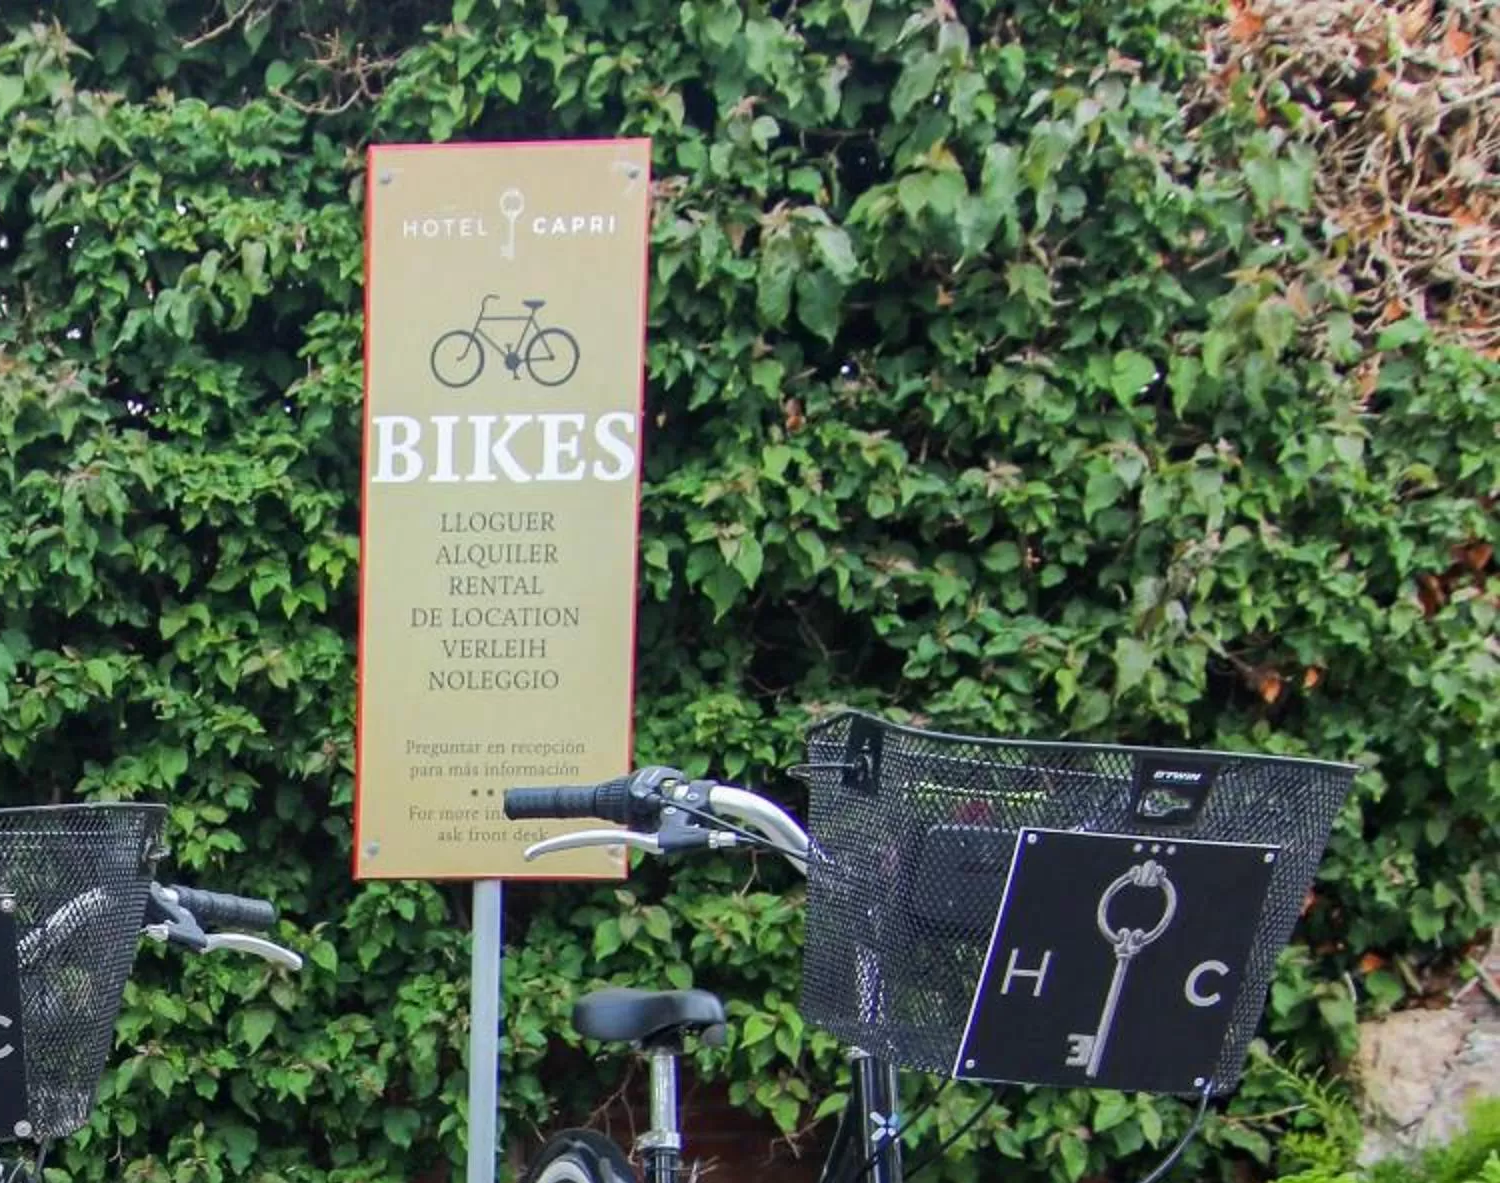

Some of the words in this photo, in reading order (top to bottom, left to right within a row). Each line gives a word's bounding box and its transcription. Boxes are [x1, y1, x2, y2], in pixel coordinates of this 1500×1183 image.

[402, 219, 489, 238] HOTEL
[532, 214, 616, 235] CAPRI
[371, 411, 636, 484] BIKES
[440, 511, 556, 534] LLOGUER
[435, 543, 558, 568] ALQUILER
[448, 575, 545, 596] RENTAL
[410, 608, 443, 628] DE
[451, 606, 580, 628] LOCATION
[442, 638, 547, 659] VERLEIH
[427, 669, 559, 691] NOLEGGIO
[405, 739, 481, 757] Preguntar
[487, 742, 505, 754] en
[409, 766, 443, 780] para
[449, 761, 479, 777] más
[485, 761, 580, 777] información
[409, 805, 432, 820] For
[439, 807, 479, 820] more
[437, 828, 461, 841] ask
[468, 827, 508, 841] front
[513, 826, 549, 841] desk
[1000, 948, 1053, 997] H
[1183, 960, 1229, 1007] C
